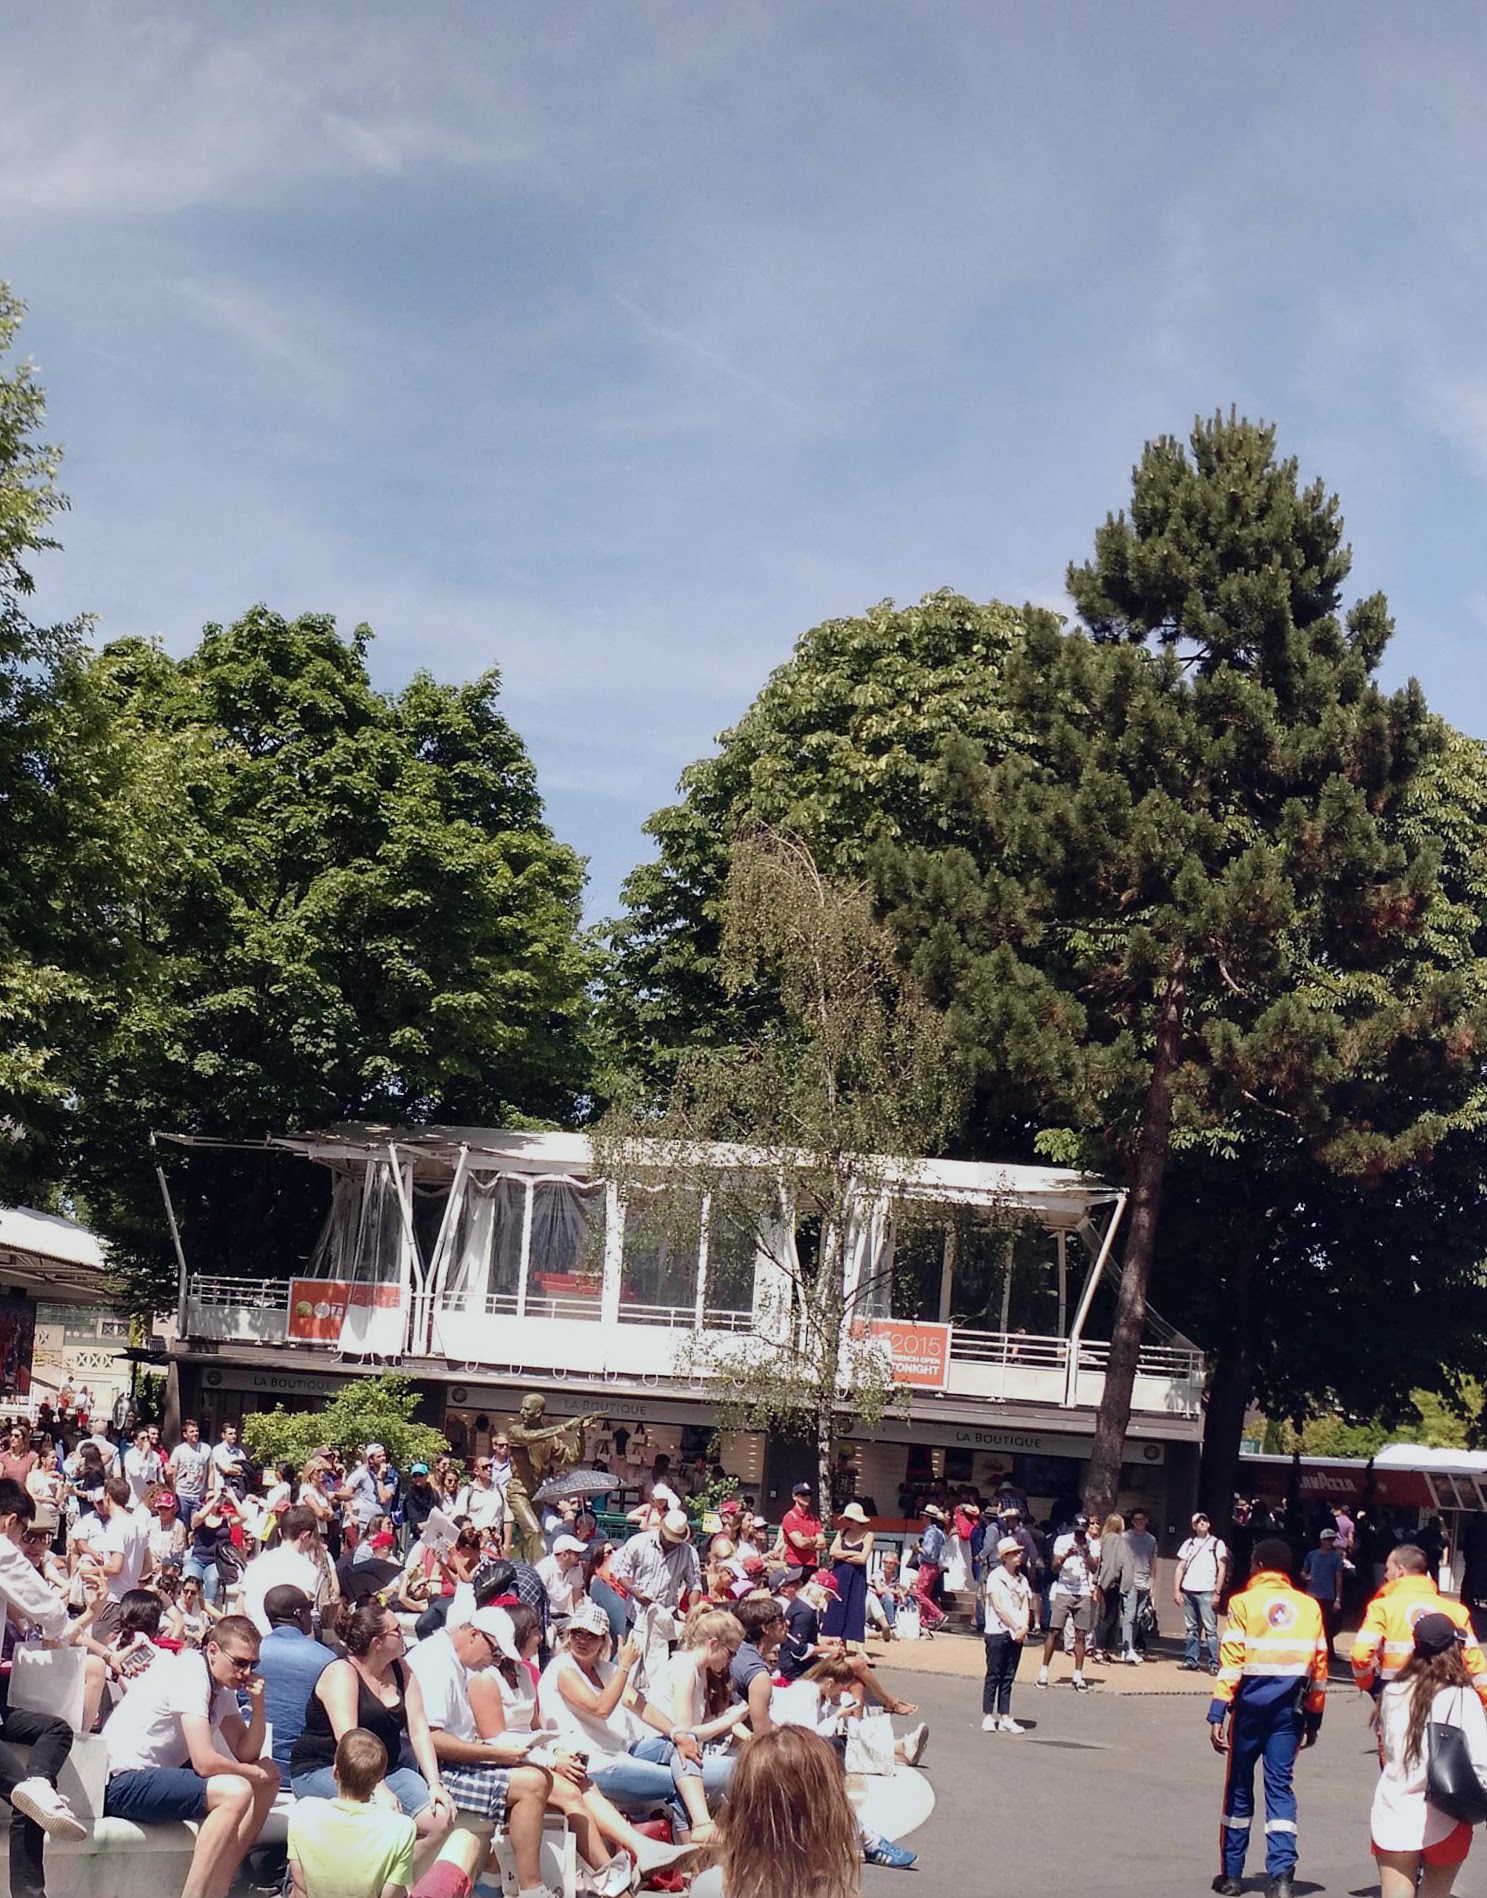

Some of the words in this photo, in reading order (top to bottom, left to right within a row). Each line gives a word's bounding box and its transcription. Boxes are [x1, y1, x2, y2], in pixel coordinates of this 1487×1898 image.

[891, 1334, 941, 1356] 2015
[920, 1356, 940, 1364] OPEN
[891, 1362, 940, 1376] TONIGHT
[254, 1377, 267, 1386] LA
[271, 1377, 333, 1391] BOUTIQUE
[564, 1399, 579, 1410] LA
[583, 1400, 647, 1416] BOUTIQUE
[956, 1431, 971, 1442] LA
[975, 1432, 1042, 1449] BOUTIQUE
